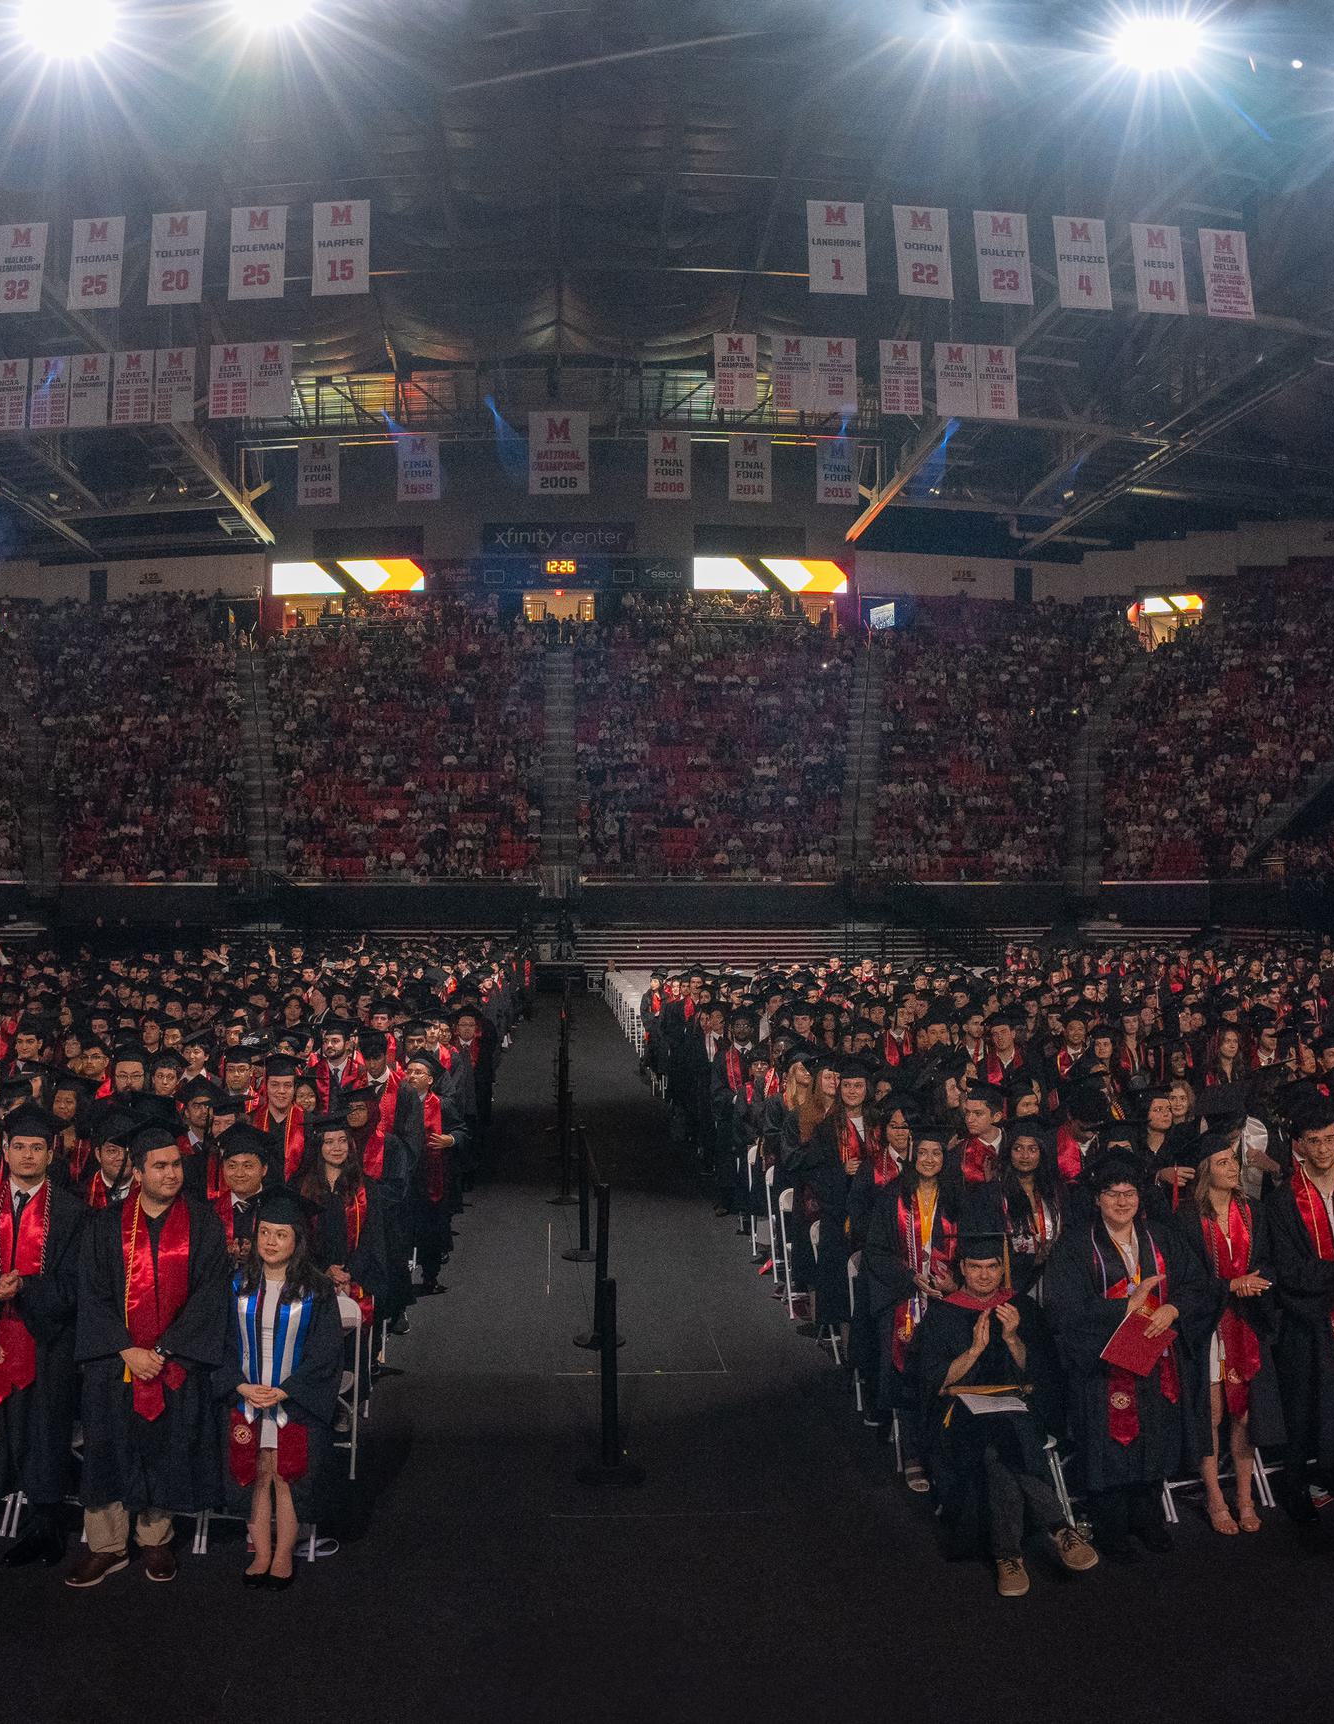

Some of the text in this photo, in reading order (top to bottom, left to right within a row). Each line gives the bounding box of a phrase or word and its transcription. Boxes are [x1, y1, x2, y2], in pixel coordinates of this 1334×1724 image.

[248, 209, 270, 231] M
[330, 205, 352, 226] M
[824, 205, 847, 226] M
[910, 210, 932, 231] M
[89, 222, 109, 242] M
[168, 215, 189, 237] M
[990, 215, 1012, 237] M
[1070, 221, 1091, 242] M
[11, 227, 32, 248] M
[318, 238, 364, 248] HARPER
[812, 238, 861, 248] LANGHORNE
[1147, 228, 1167, 248] M
[155, 248, 201, 259] TOLIVER
[231, 242, 284, 253] COLEMAN
[904, 242, 943, 252] DORON
[980, 248, 1025, 258] BULLETT
[75, 254, 119, 264] THOMAS
[1059, 254, 1105, 264] PERAZIC
[1143, 259, 1175, 269] HEISS
[242, 264, 271, 286] 25
[327, 259, 354, 282] 15
[831, 258, 844, 281] 1
[912, 262, 939, 285] 22
[80, 274, 108, 296] 25
[161, 269, 190, 291] 20
[992, 268, 1020, 290] 23
[1078, 274, 1093, 296] 4
[3, 279, 30, 301] 32
[1149, 279, 1175, 301] 44
[264, 345, 280, 362] M
[727, 337, 744, 354] M
[784, 339, 801, 356] M
[827, 341, 844, 359] M
[126, 354, 142, 371] M
[167, 351, 183, 369] M
[223, 346, 239, 364] M
[947, 346, 963, 363] M
[987, 348, 1003, 365] M
[3, 362, 17, 379] M
[83, 356, 98, 374] M
[162, 369, 188, 377] SWEET
[259, 369, 284, 378] EIGHT
[260, 363, 283, 371] ELITE
[120, 371, 146, 379] SWEET
[158, 376, 192, 384] SIXTEEN
[218, 371, 242, 379] EIGHT
[546, 417, 571, 444] M
[537, 450, 580, 460] NATIONAL
[654, 458, 684, 468] FINAL
[303, 464, 332, 473] FINAL
[403, 460, 432, 470] FINAL
[532, 461, 586, 471] CHAMPIONS
[655, 468, 683, 477] FOUR
[735, 461, 765, 470] FINAL
[823, 464, 852, 473] FINAL
[305, 473, 331, 482] FOUR
[405, 469, 432, 479] FOUR
[540, 476, 578, 489] 2006
[737, 470, 764, 480] FOUR
[824, 472, 851, 482] FOUR
[736, 484, 764, 495] 2014
[824, 487, 852, 498] 2015
[495, 527, 624, 549] xfinity center
[546, 560, 576, 574] 12:26
[651, 570, 682, 578] secu
